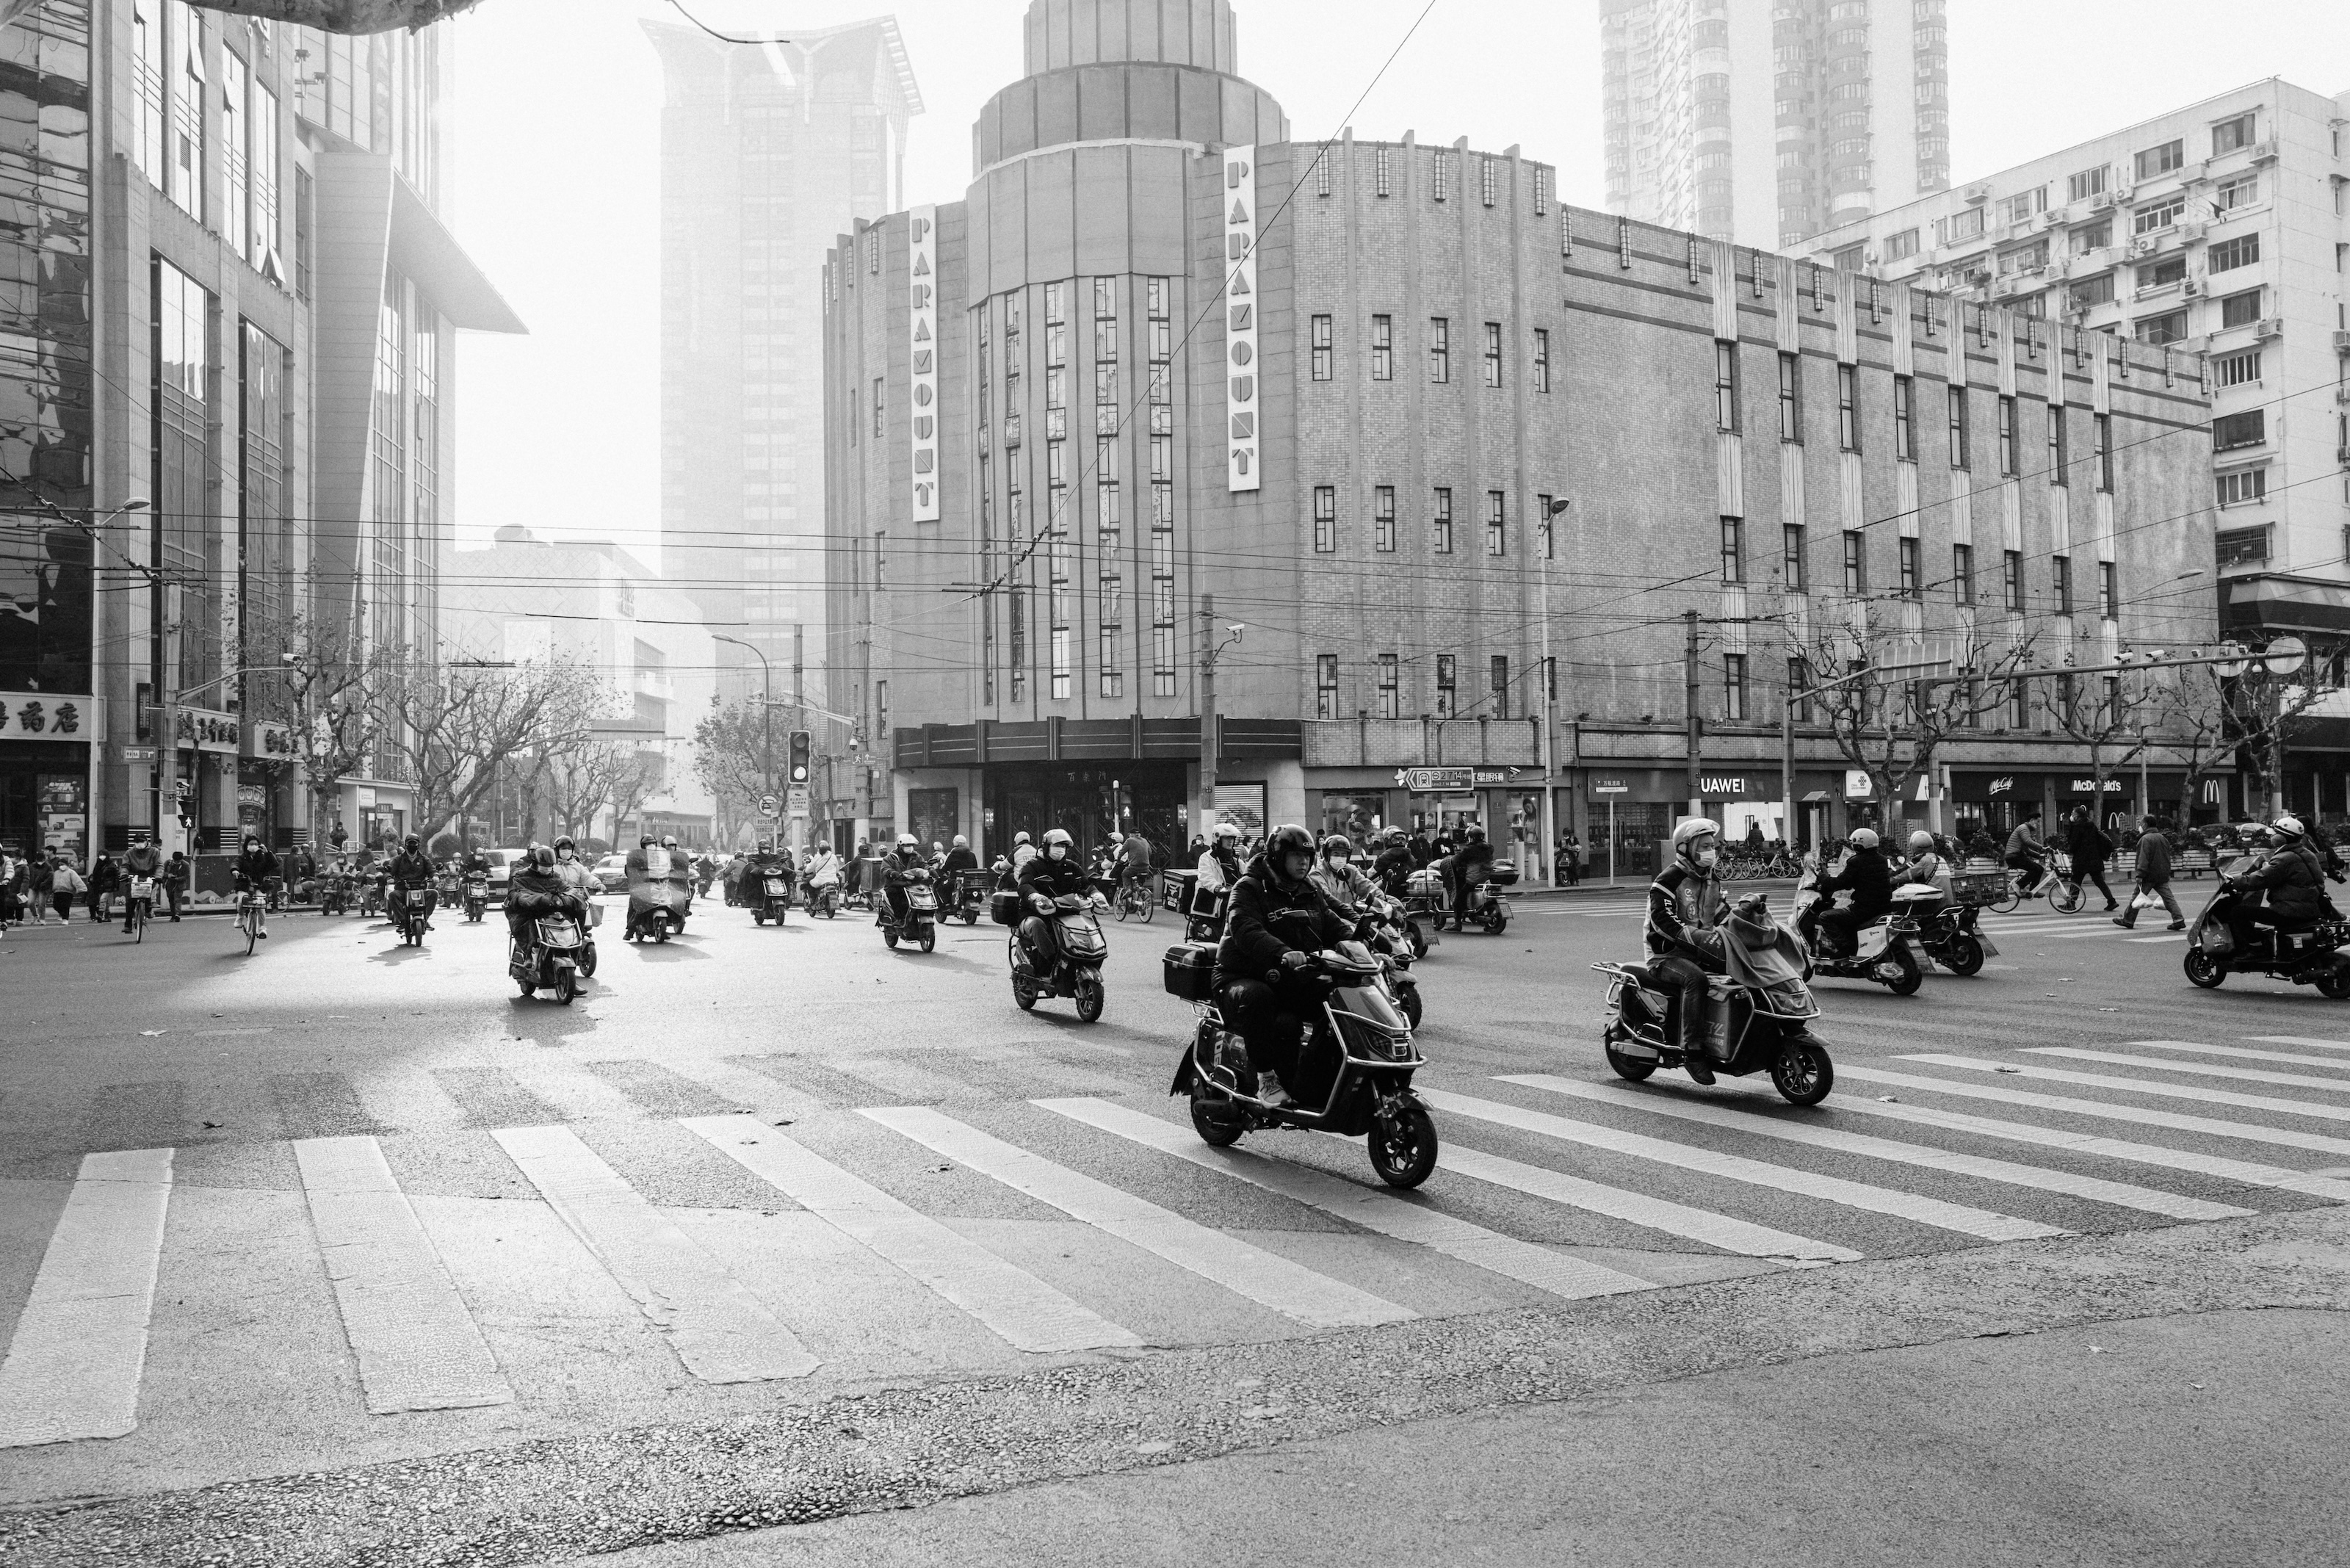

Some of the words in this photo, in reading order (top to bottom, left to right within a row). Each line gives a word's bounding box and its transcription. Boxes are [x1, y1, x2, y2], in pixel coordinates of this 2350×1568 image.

[911, 217, 934, 506] PARAMOUNT
[1227, 161, 1254, 474] PARAMOUNT
[1701, 778, 1745, 792] UAWEI
[2072, 779, 2122, 792] McDoald's
